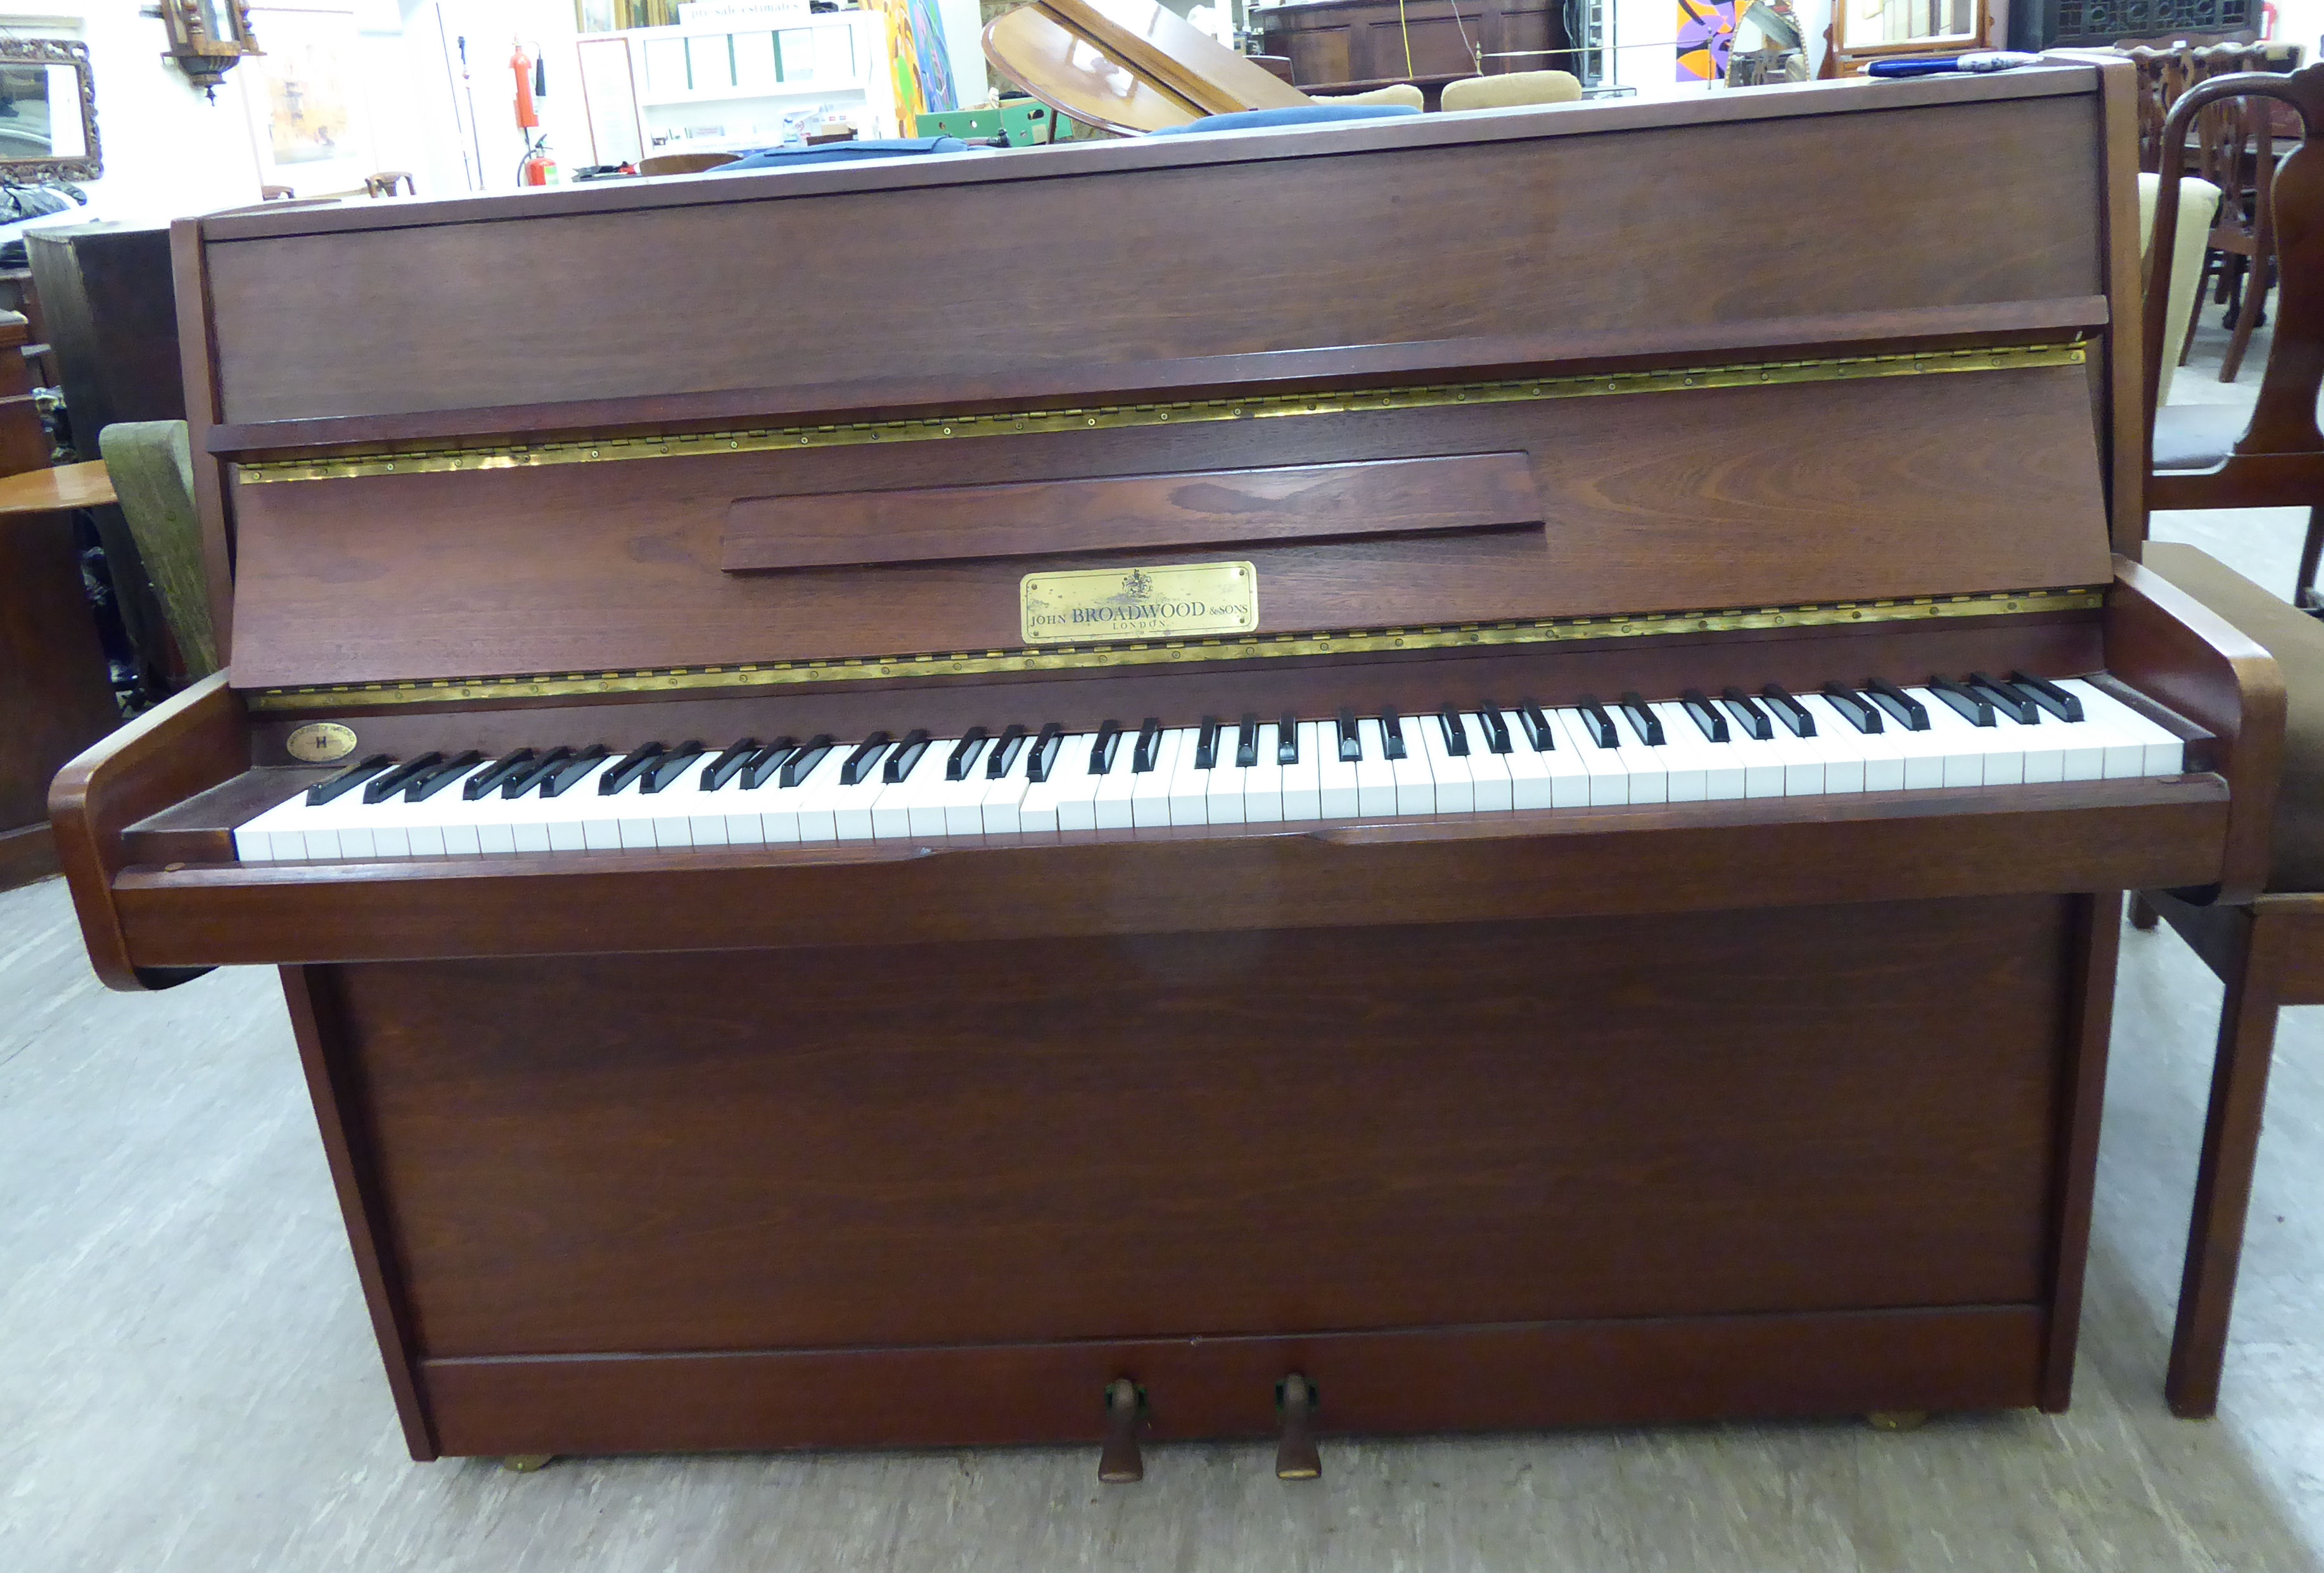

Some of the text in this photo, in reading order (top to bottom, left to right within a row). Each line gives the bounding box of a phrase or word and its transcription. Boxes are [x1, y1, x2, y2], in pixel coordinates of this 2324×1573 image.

[741, 3, 798, 13] estimates
[1031, 614, 1066, 627] JOHN
[1072, 602, 1205, 623] BROADWOOD
[1113, 620, 1166, 630] LONDON
[316, 736, 328, 748] H
